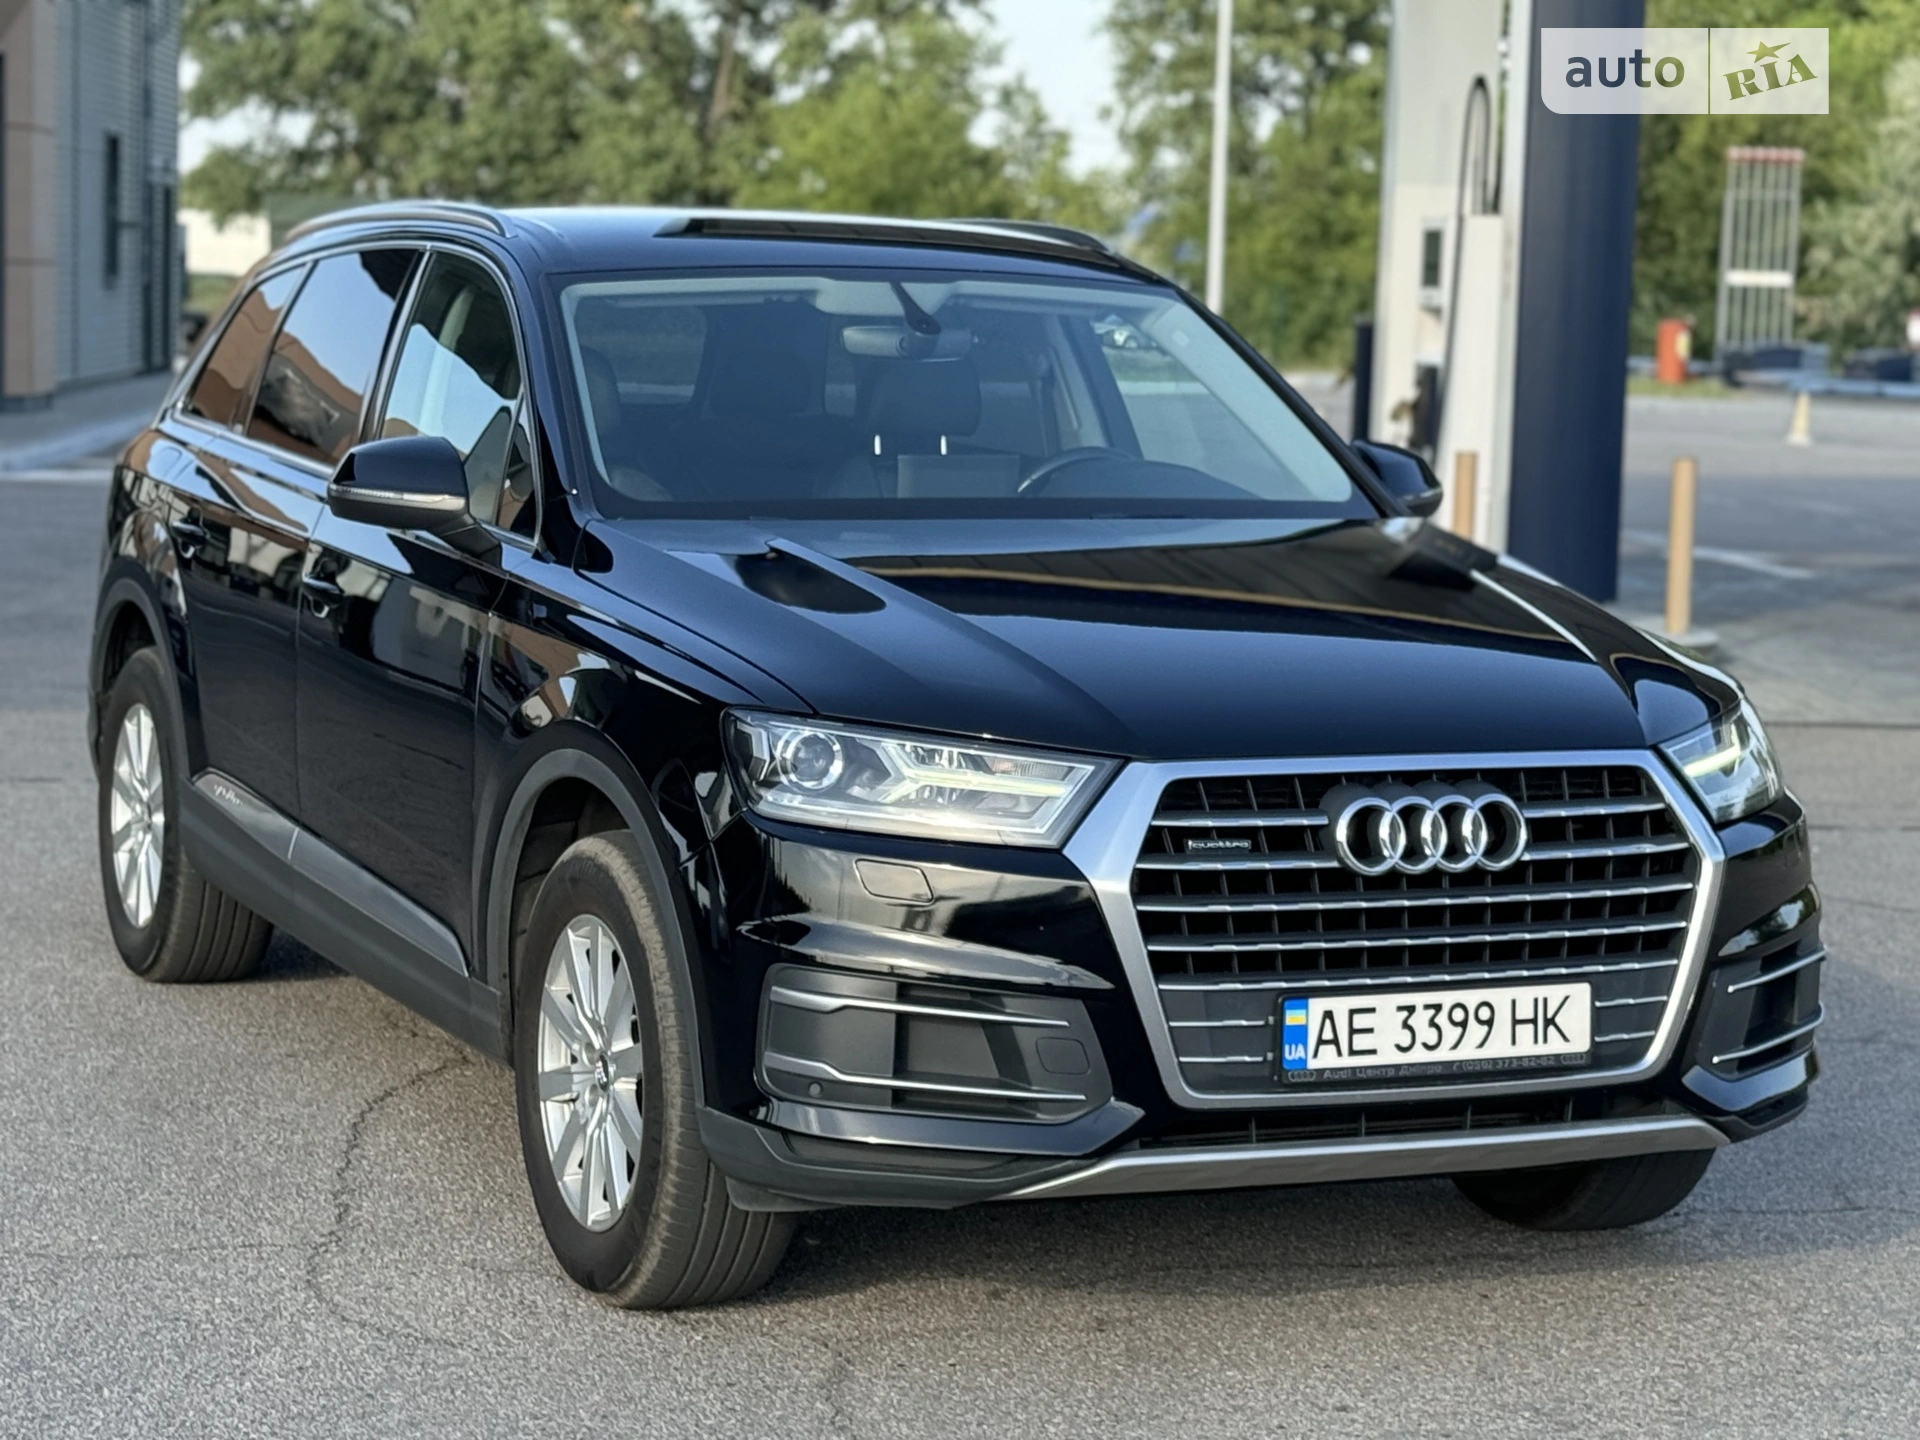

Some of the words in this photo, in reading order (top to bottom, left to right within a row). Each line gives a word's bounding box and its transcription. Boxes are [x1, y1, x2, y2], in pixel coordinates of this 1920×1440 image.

[1312, 1007, 1377, 1059] AE
[1394, 1001, 1495, 1053] 3399
[1511, 995, 1570, 1046] HK
[1285, 1044, 1306, 1060] UA
[1323, 1069, 1351, 1079] Audi
